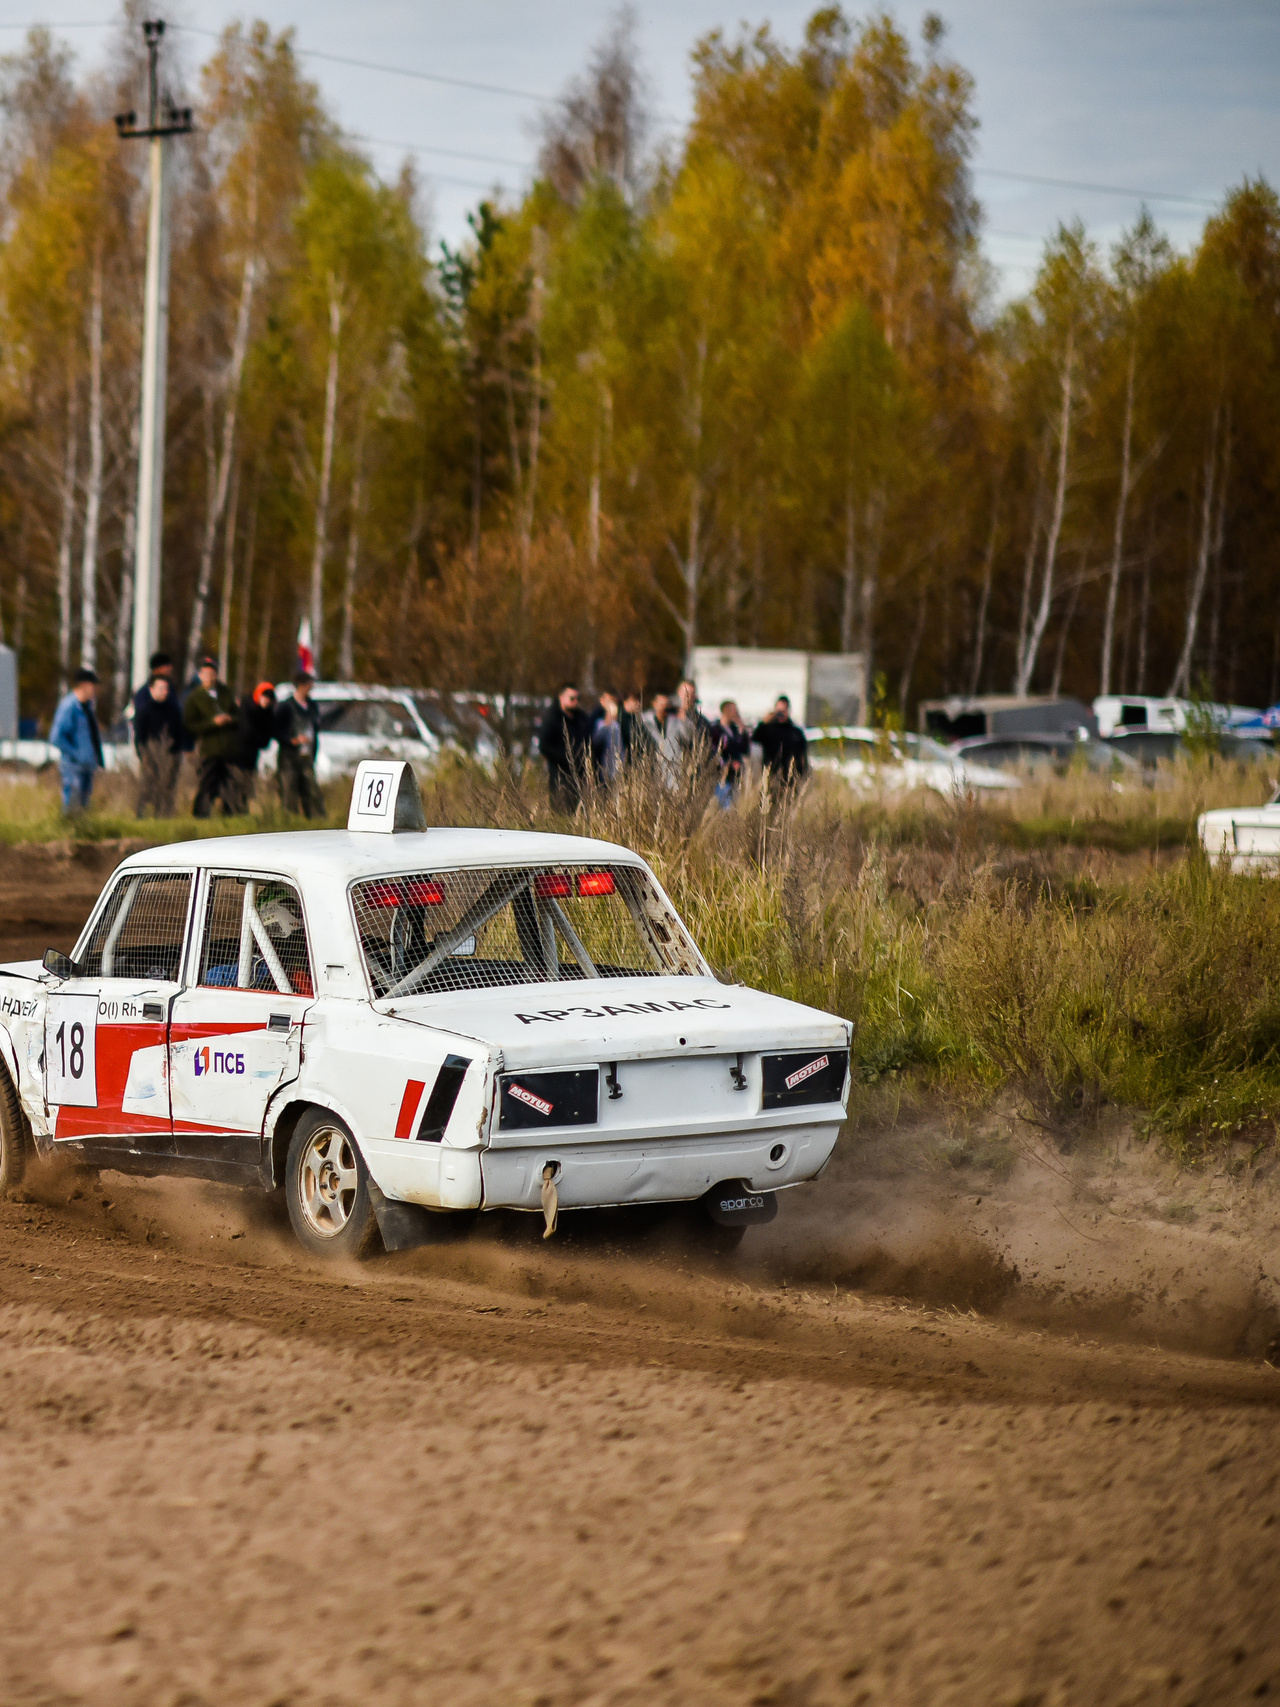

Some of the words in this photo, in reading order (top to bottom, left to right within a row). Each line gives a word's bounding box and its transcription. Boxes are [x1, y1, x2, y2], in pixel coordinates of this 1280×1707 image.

[367, 779, 384, 809] 18
[514, 999, 731, 1025] АРЗАМАС
[56, 1021, 85, 1080] 18
[214, 1052, 245, 1075] ПСБ
[789, 1060, 826, 1085] MOTUL
[510, 1086, 550, 1112] MOTUL
